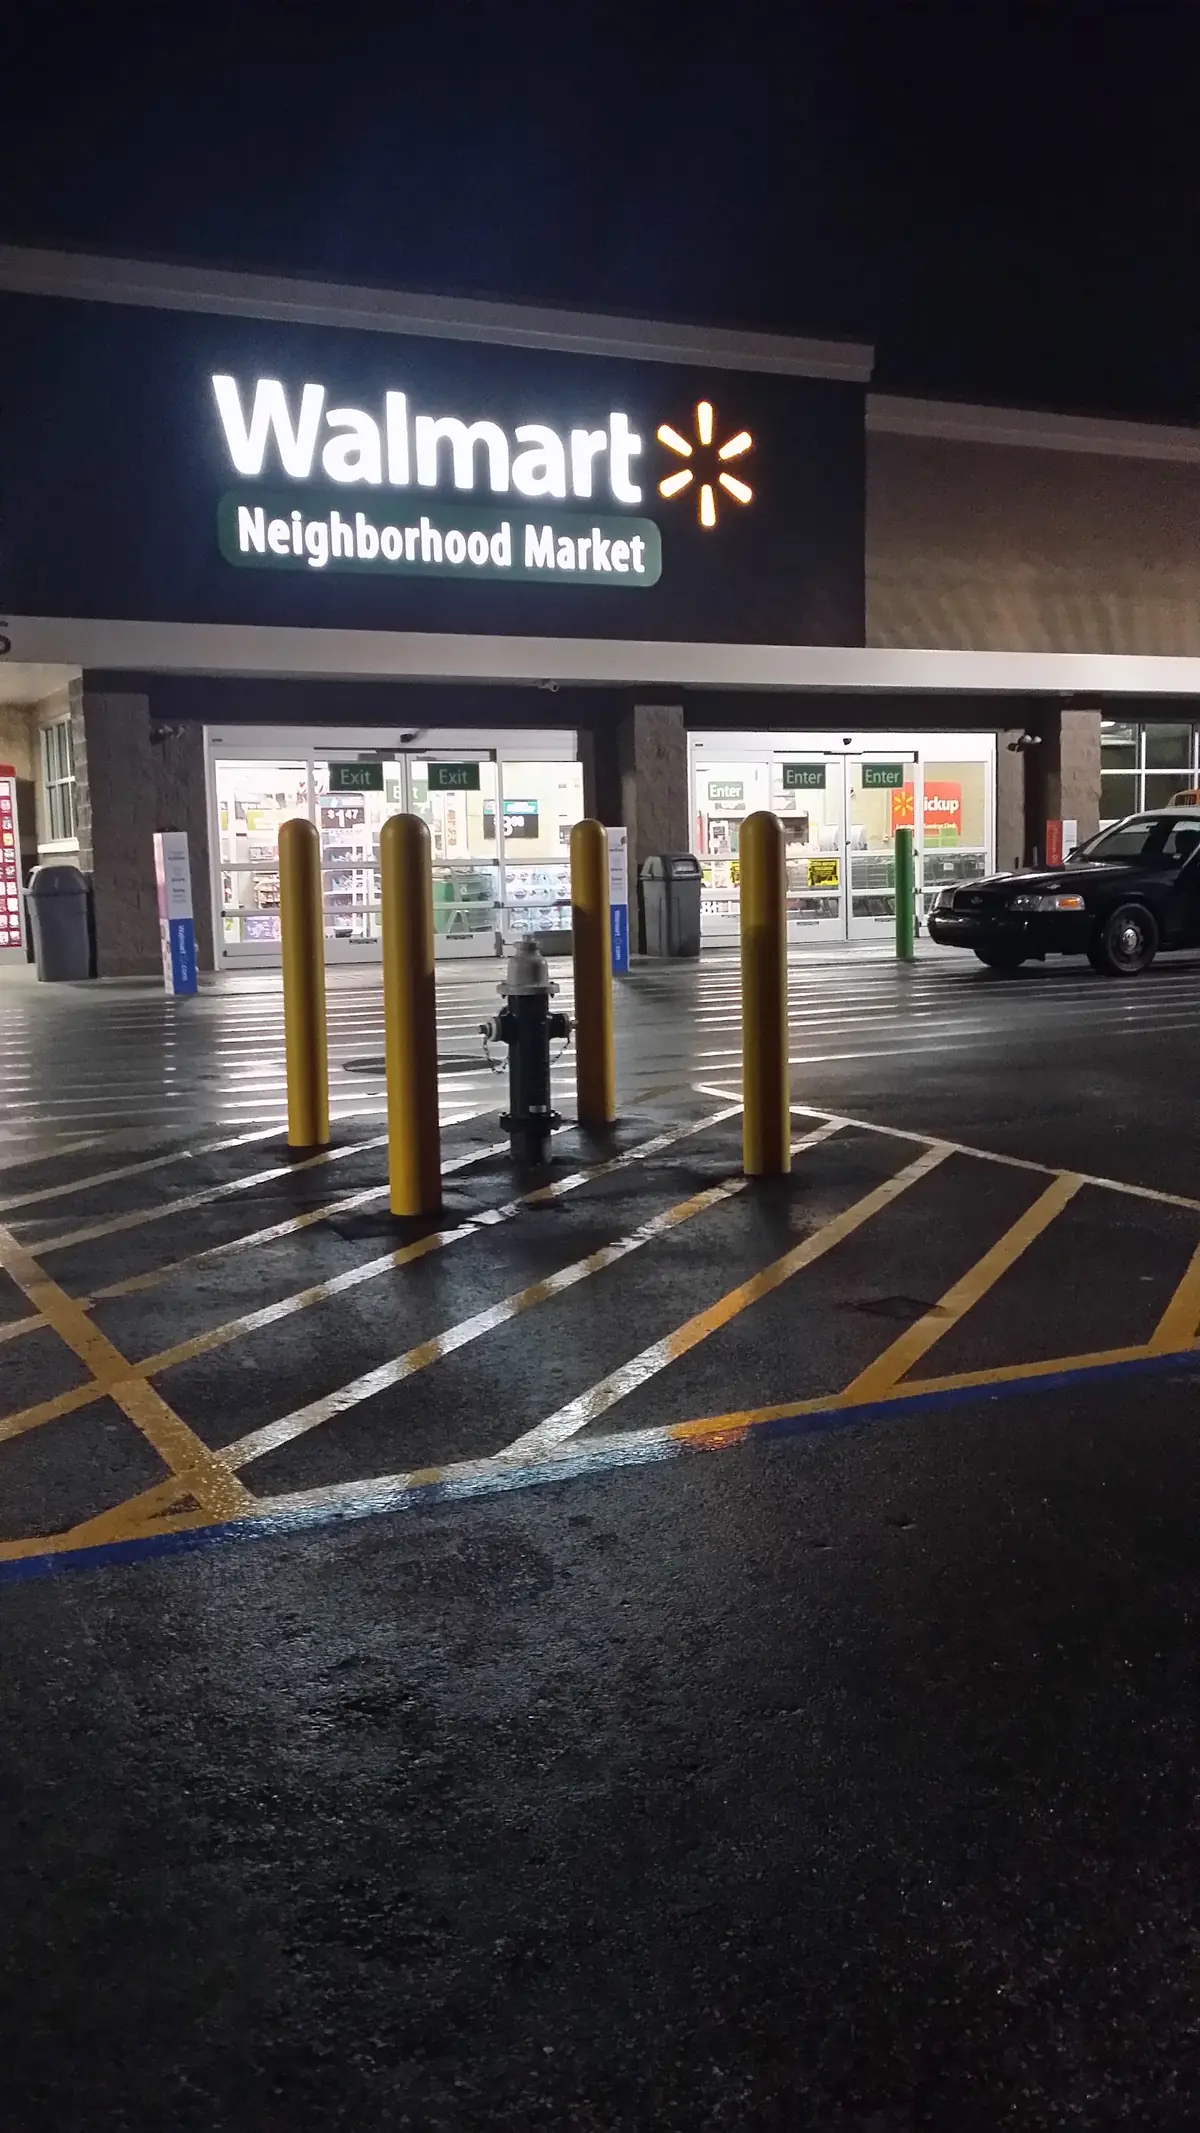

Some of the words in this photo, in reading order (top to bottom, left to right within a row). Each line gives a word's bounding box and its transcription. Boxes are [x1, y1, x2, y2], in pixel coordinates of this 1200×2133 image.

[212, 374, 643, 504] Walmart
[237, 505, 512, 568] Neighborhood
[524, 523, 646, 574] Market
[340, 768, 371, 785] Exit
[439, 768, 468, 785] Exit
[786, 769, 822, 784] Enter
[865, 769, 900, 784] Enter
[709, 784, 742, 799] Enter
[923, 795, 960, 815] ickup
